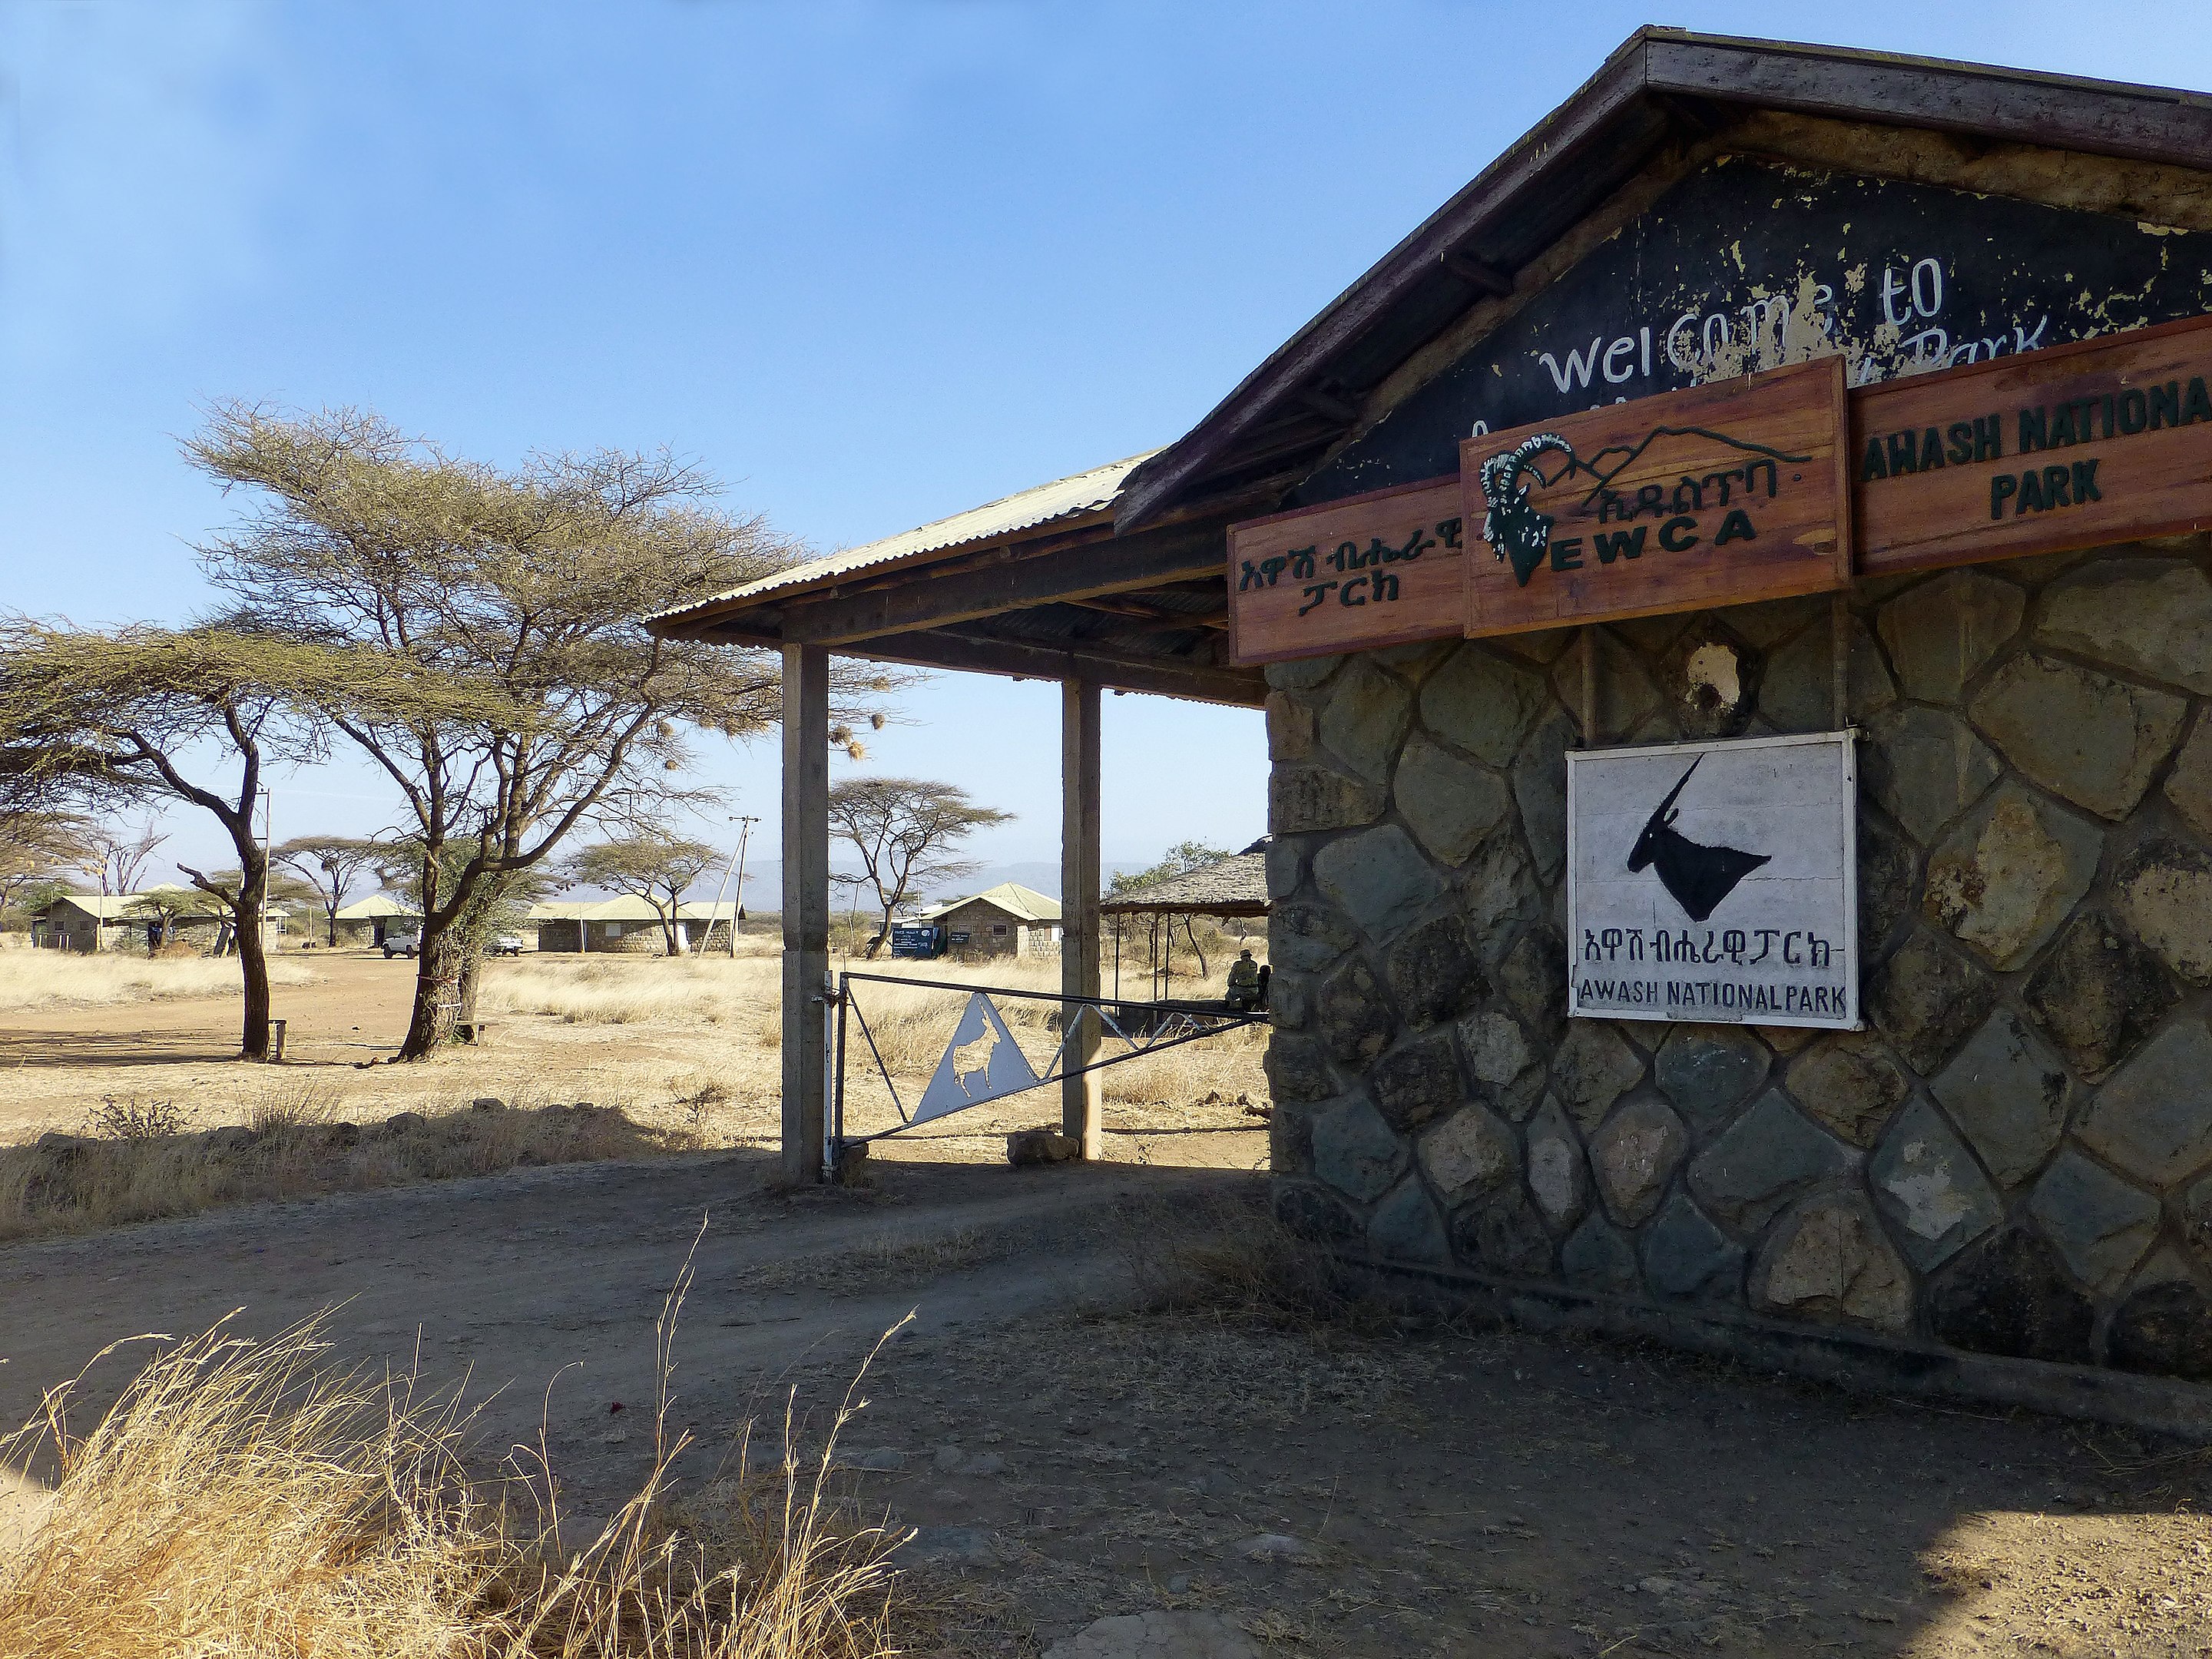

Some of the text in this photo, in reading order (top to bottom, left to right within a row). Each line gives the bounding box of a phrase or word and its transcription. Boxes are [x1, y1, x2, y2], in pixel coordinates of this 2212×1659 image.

[1862, 412, 2002, 482] AWASH
[1991, 459, 2102, 520] PARK
[1551, 508, 1757, 571] EWCA
[1580, 979, 1659, 1005] AWASH
